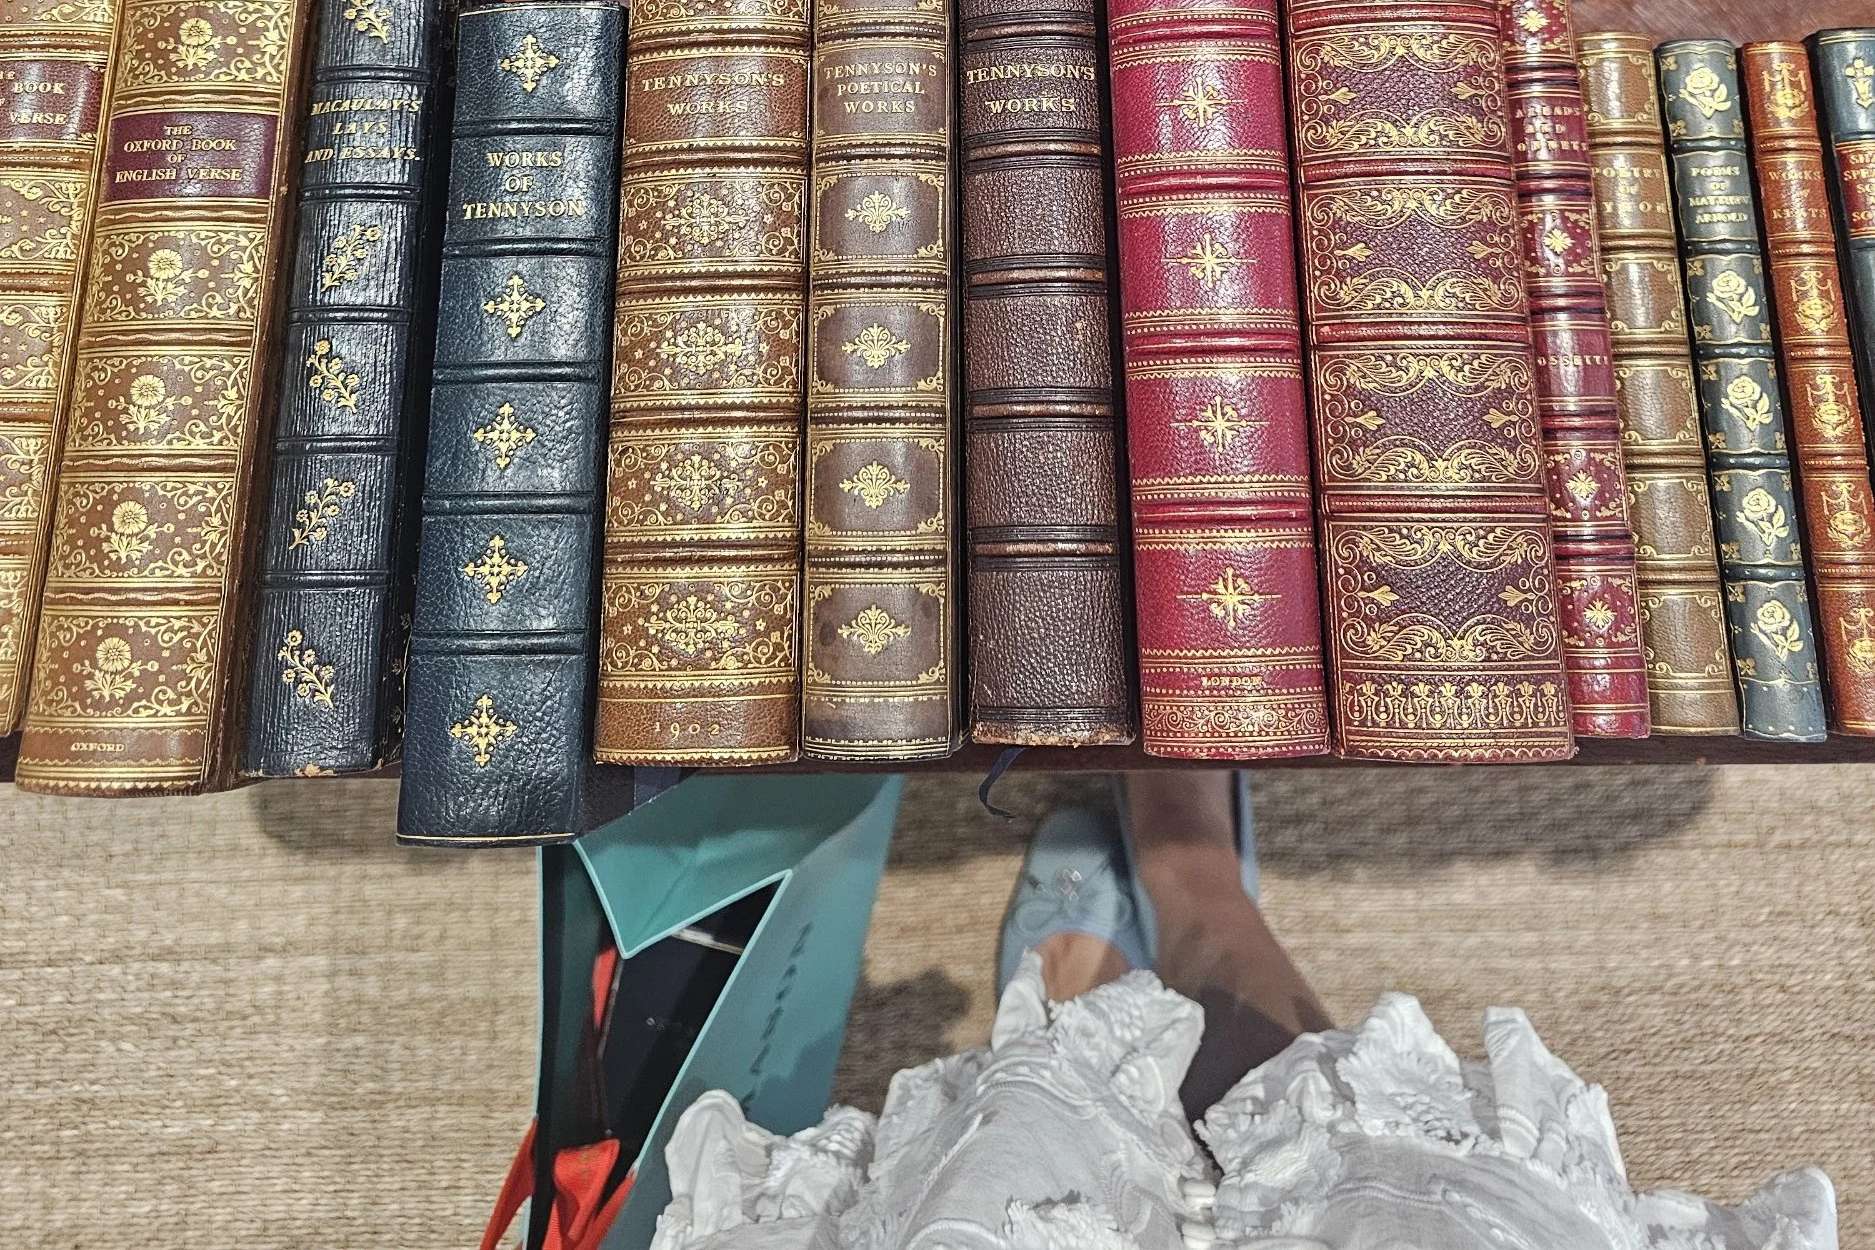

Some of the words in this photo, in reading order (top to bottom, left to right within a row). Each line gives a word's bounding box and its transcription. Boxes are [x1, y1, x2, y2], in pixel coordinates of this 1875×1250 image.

[824, 62, 937, 79] TENNYSON'S
[966, 64, 1095, 84] TENNYSON'S
[13, 82, 66, 94] BOOK
[642, 73, 785, 91] TENNYSON'S
[837, 81, 925, 96] POETICAL
[311, 98, 423, 116] MACAULAY'S
[667, 101, 748, 115] WORKS
[844, 101, 915, 114] WORKS
[985, 97, 1076, 115] WORKS
[10, 111, 67, 125] VERSE
[164, 125, 192, 136] THE
[332, 121, 388, 135] LAYS
[123, 139, 184, 153] OXFORD
[191, 139, 236, 151] BOOK
[1517, 139, 1588, 151] ONNETS
[168, 153, 187, 164] OF
[304, 148, 334, 163] AND
[340, 146, 421, 161] ESSAYS.
[487, 151, 562, 167] WORKS
[115, 168, 177, 183] ENGLISH
[186, 168, 242, 181] VERSE
[1691, 166, 1740, 177] POEMS
[1769, 170, 1821, 180] WORKS
[505, 175, 534, 192] OF
[1710, 182, 1727, 190] OF
[462, 200, 586, 220] TENNYSON
[1772, 208, 1827, 219] KEATS
[1695, 212, 1748, 224] ARNOLD
[1537, 354, 1609, 366] OSSETTI
[1200, 676, 1262, 687] LONDON
[655, 721, 720, 740] 1902
[71, 742, 125, 752] OXFORD
